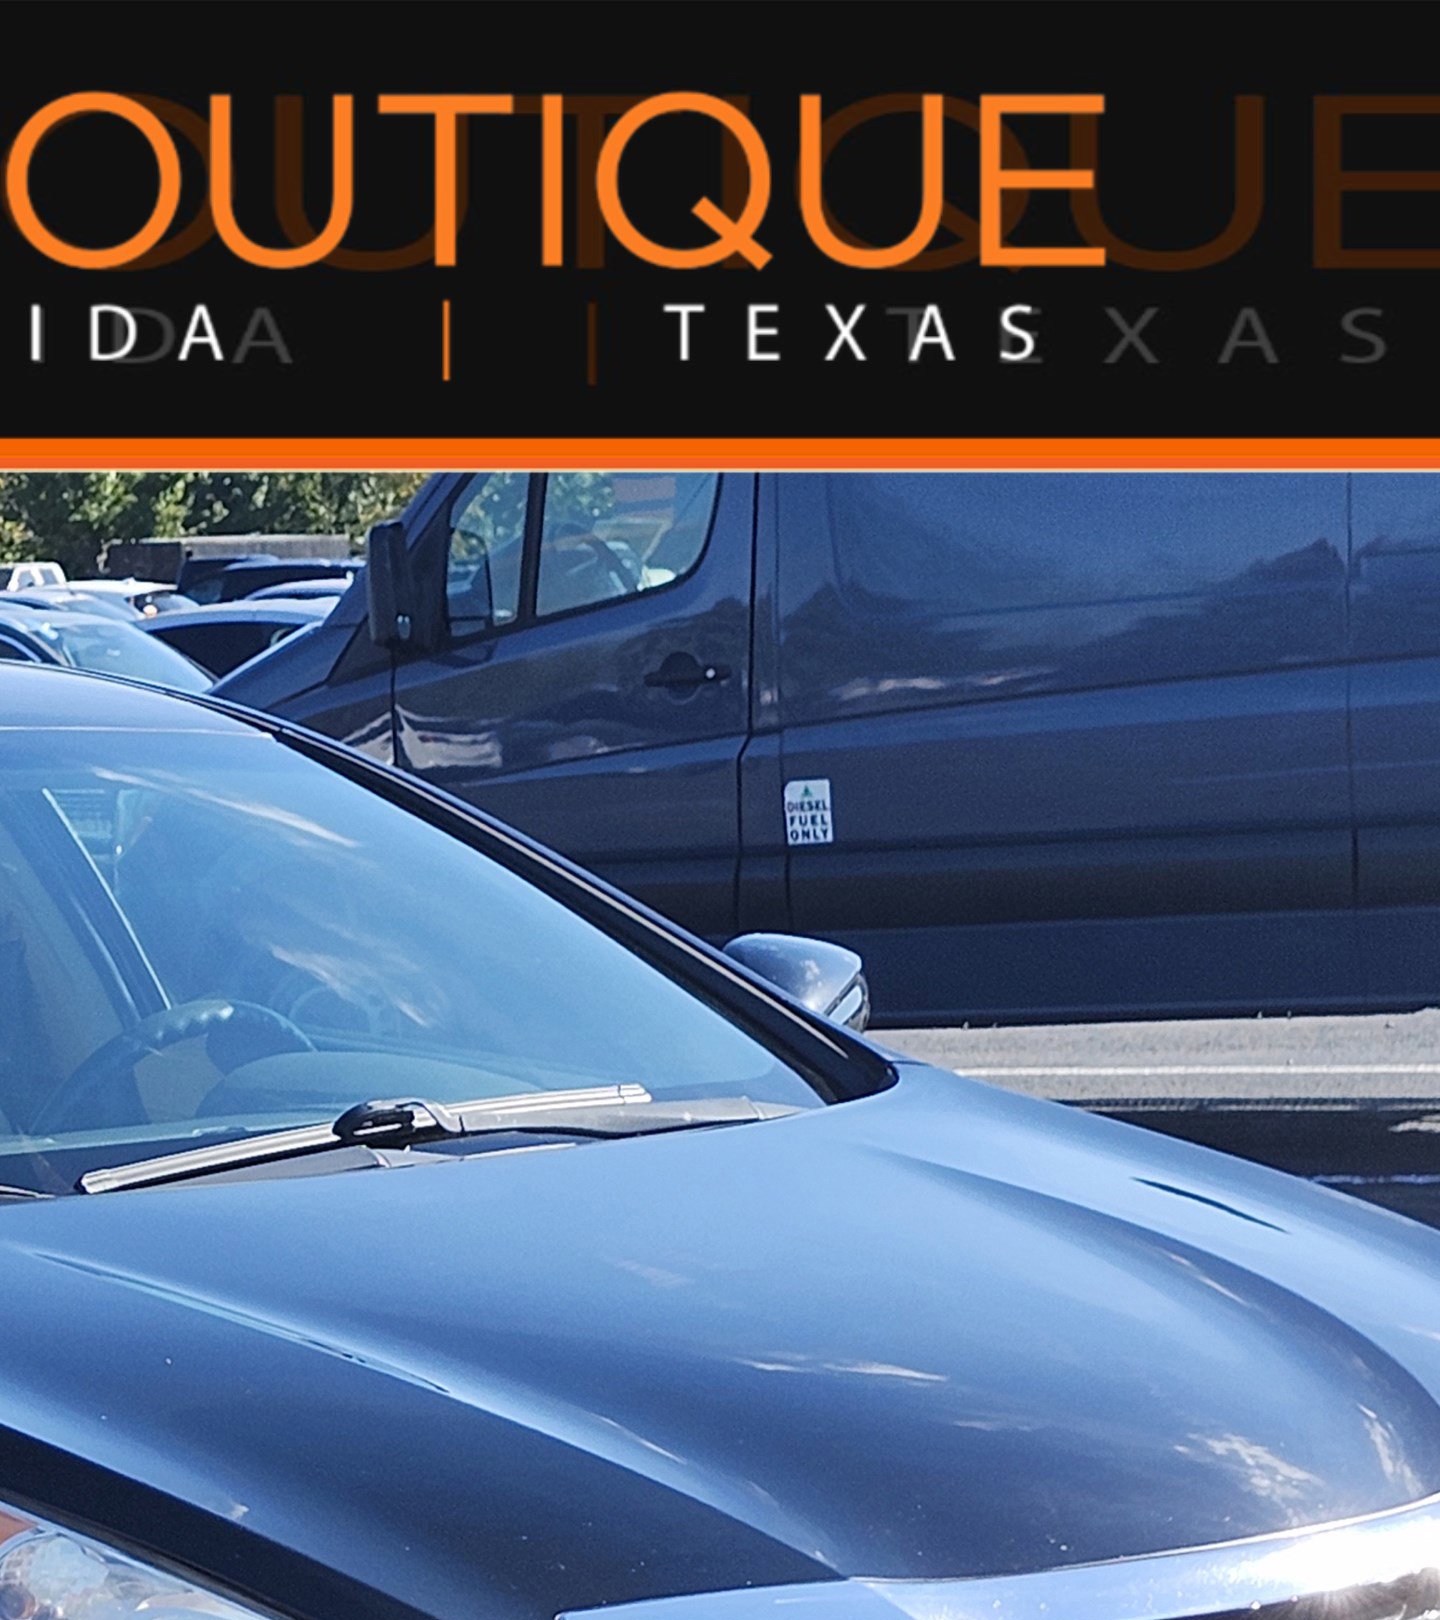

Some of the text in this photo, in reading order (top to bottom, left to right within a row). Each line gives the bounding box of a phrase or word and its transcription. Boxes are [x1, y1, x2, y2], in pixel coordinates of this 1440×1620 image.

[787, 800, 829, 812] DIESEL
[789, 814, 829, 827] FUEL
[789, 828, 829, 841] ONLY
